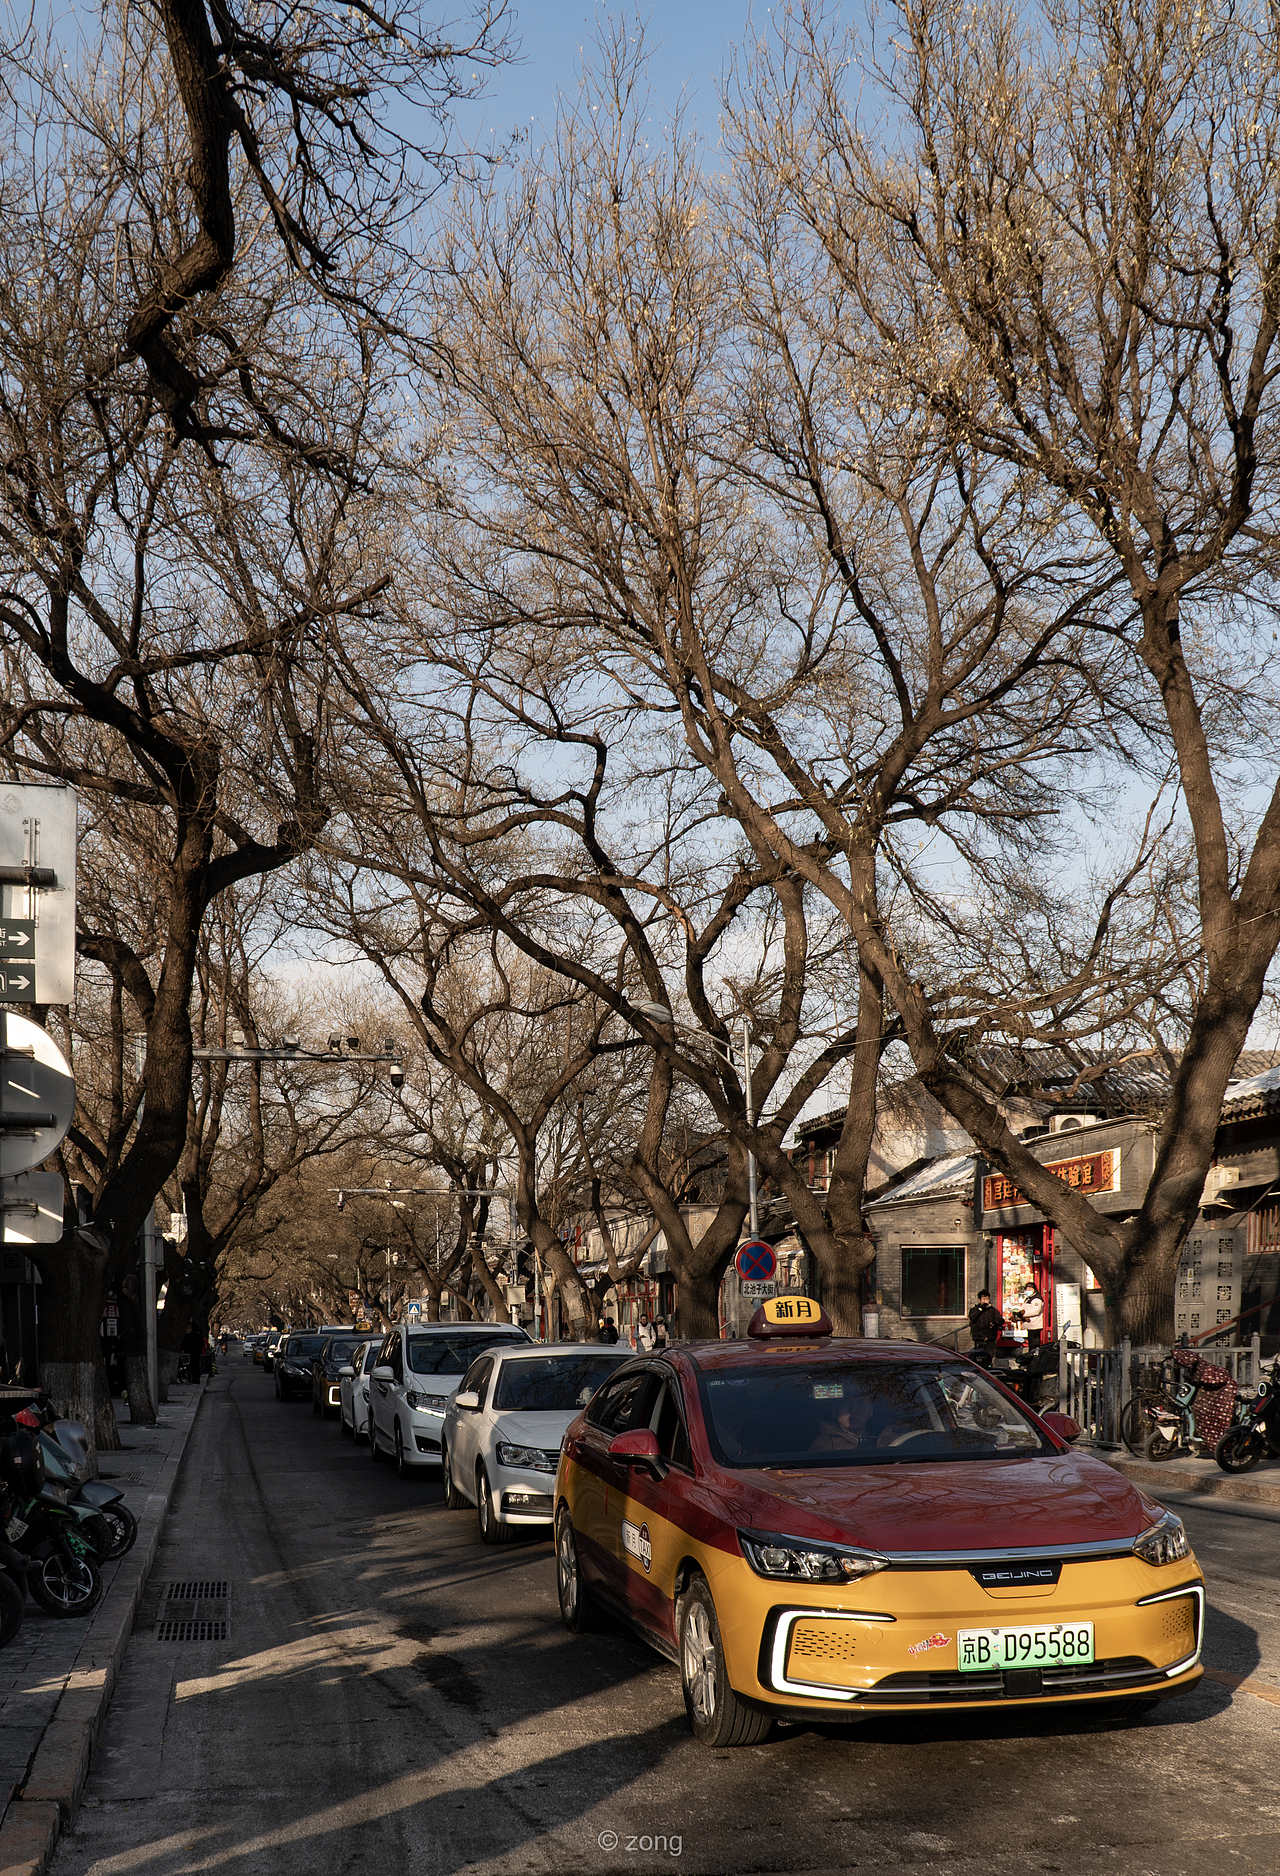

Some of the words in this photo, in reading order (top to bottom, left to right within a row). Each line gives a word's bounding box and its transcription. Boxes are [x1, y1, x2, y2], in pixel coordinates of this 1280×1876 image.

[743, 1283, 774, 1296] 北池子大街
[775, 1300, 812, 1318] 新月
[813, 1383, 843, 1399] 空车
[982, 1569, 1053, 1580] BEIJING
